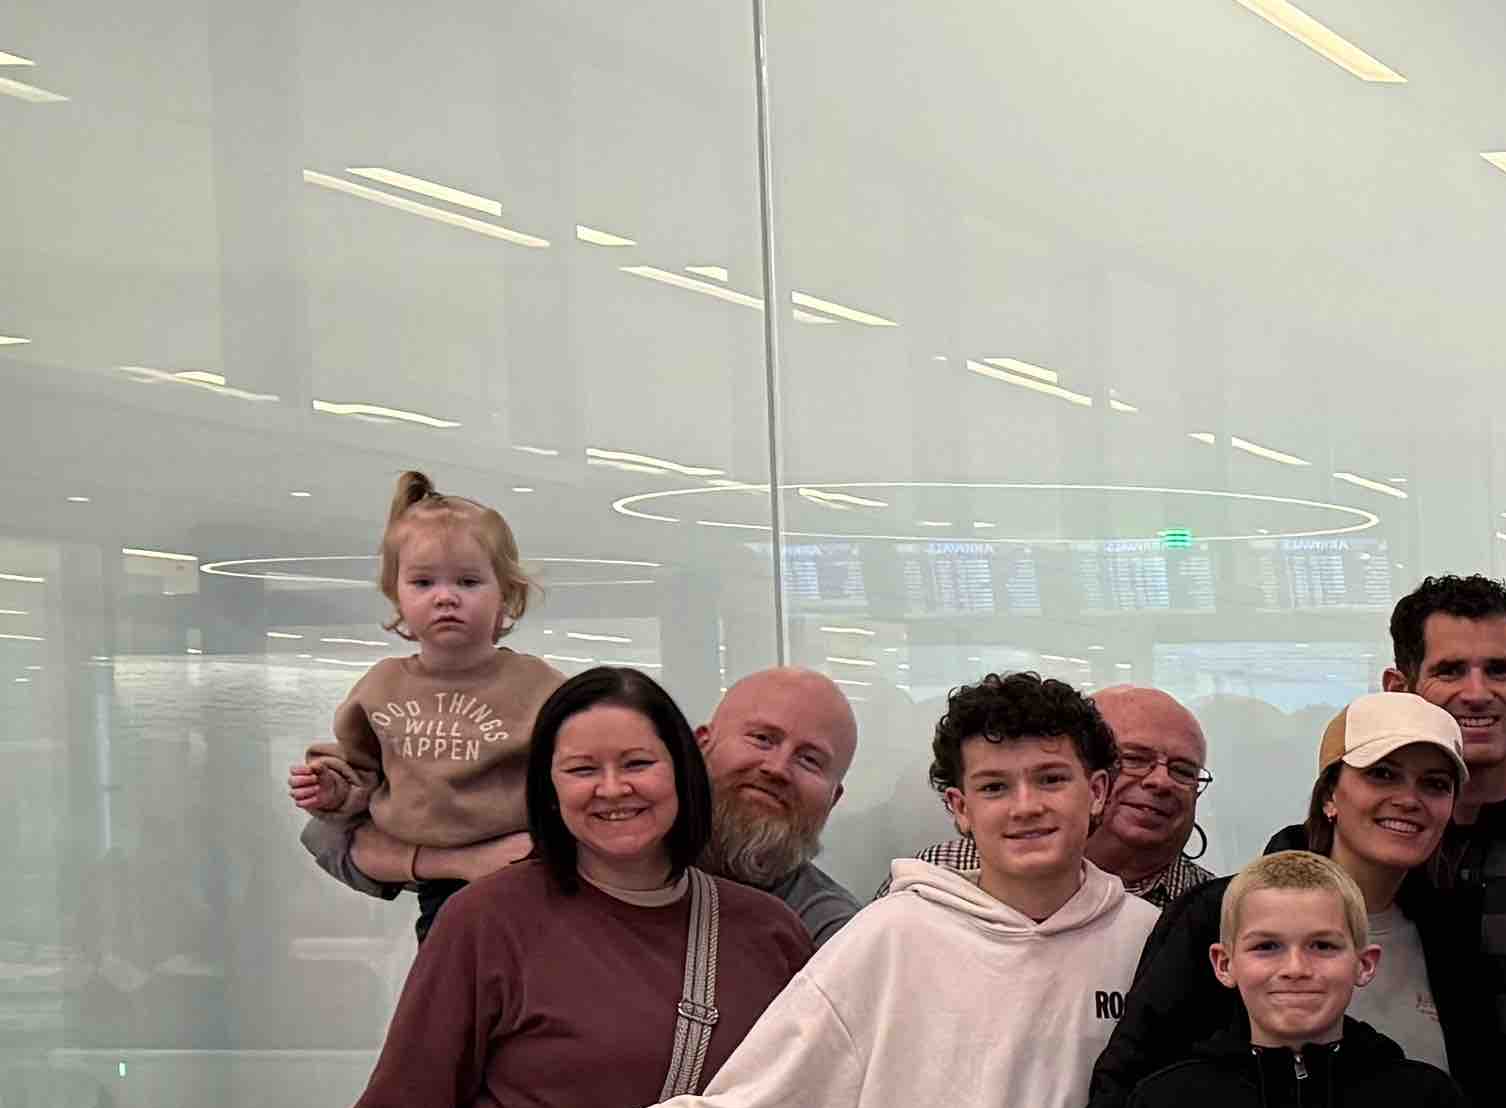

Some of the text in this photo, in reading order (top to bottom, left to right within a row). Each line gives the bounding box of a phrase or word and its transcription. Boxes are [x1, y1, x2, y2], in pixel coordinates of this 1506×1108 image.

[371, 692, 509, 742] OOD THINGS
[405, 719, 461, 737] WILL
[390, 736, 479, 761] APPEN
